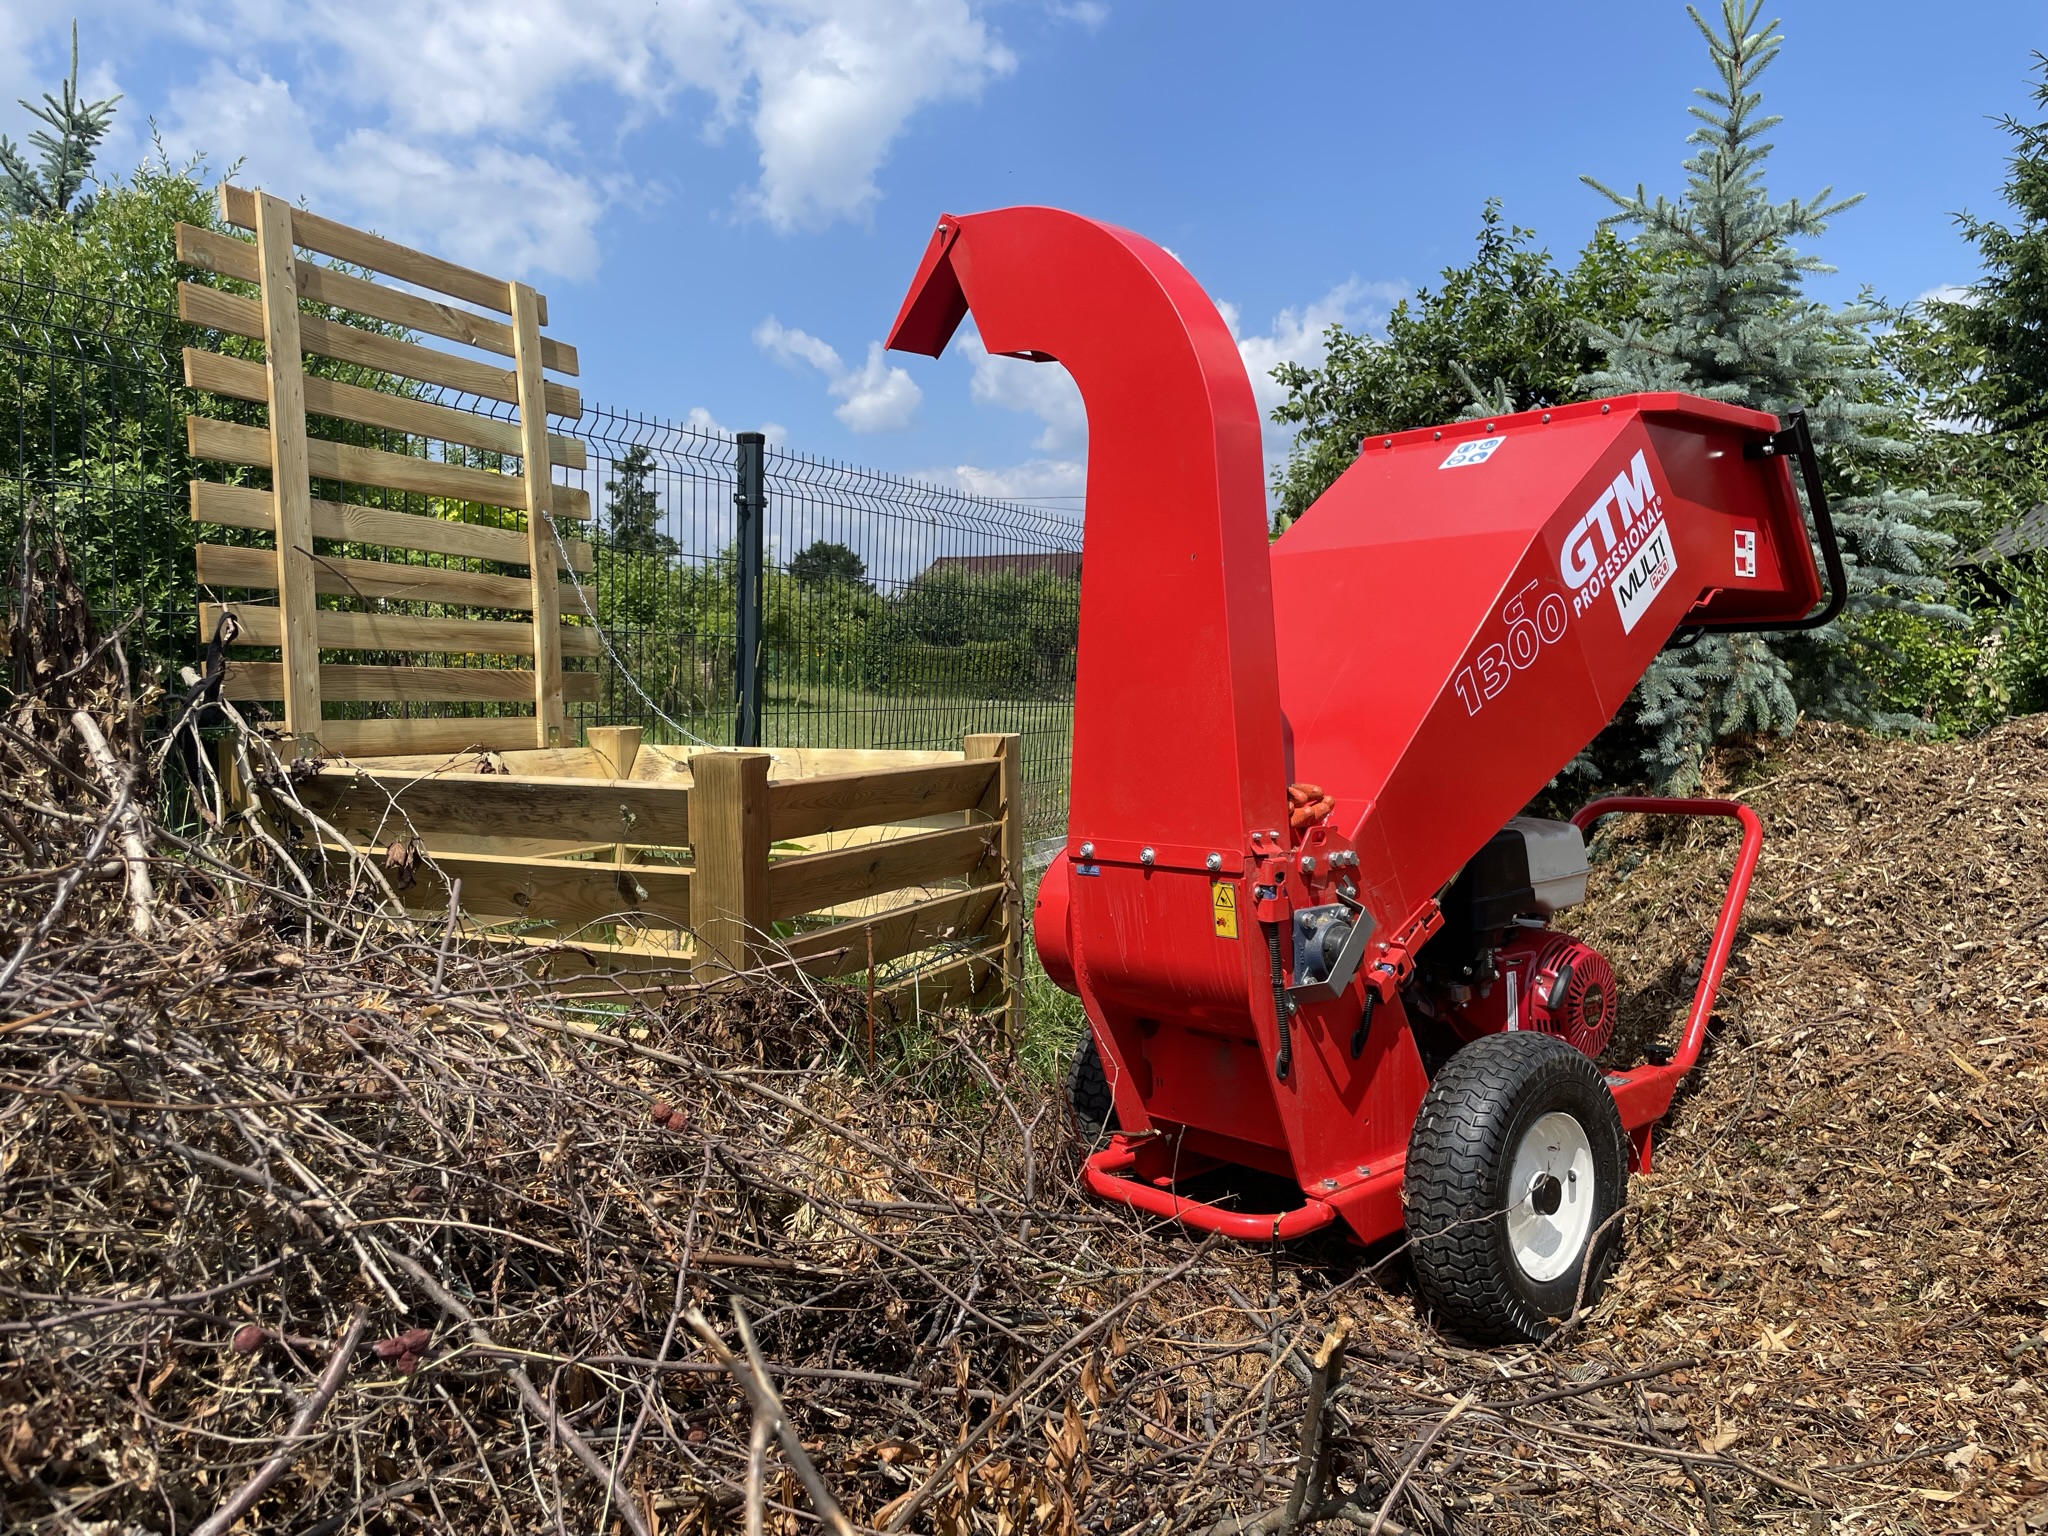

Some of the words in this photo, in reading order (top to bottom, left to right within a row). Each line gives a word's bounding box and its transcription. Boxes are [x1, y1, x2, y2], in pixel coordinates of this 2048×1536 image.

[1560, 448, 1656, 590] GTM
[1572, 501, 1663, 619] PROFESSIONAL
[1619, 535, 1666, 609] MULTI
[1651, 558, 1669, 590] PRO
[1455, 593, 1568, 716] 1300
